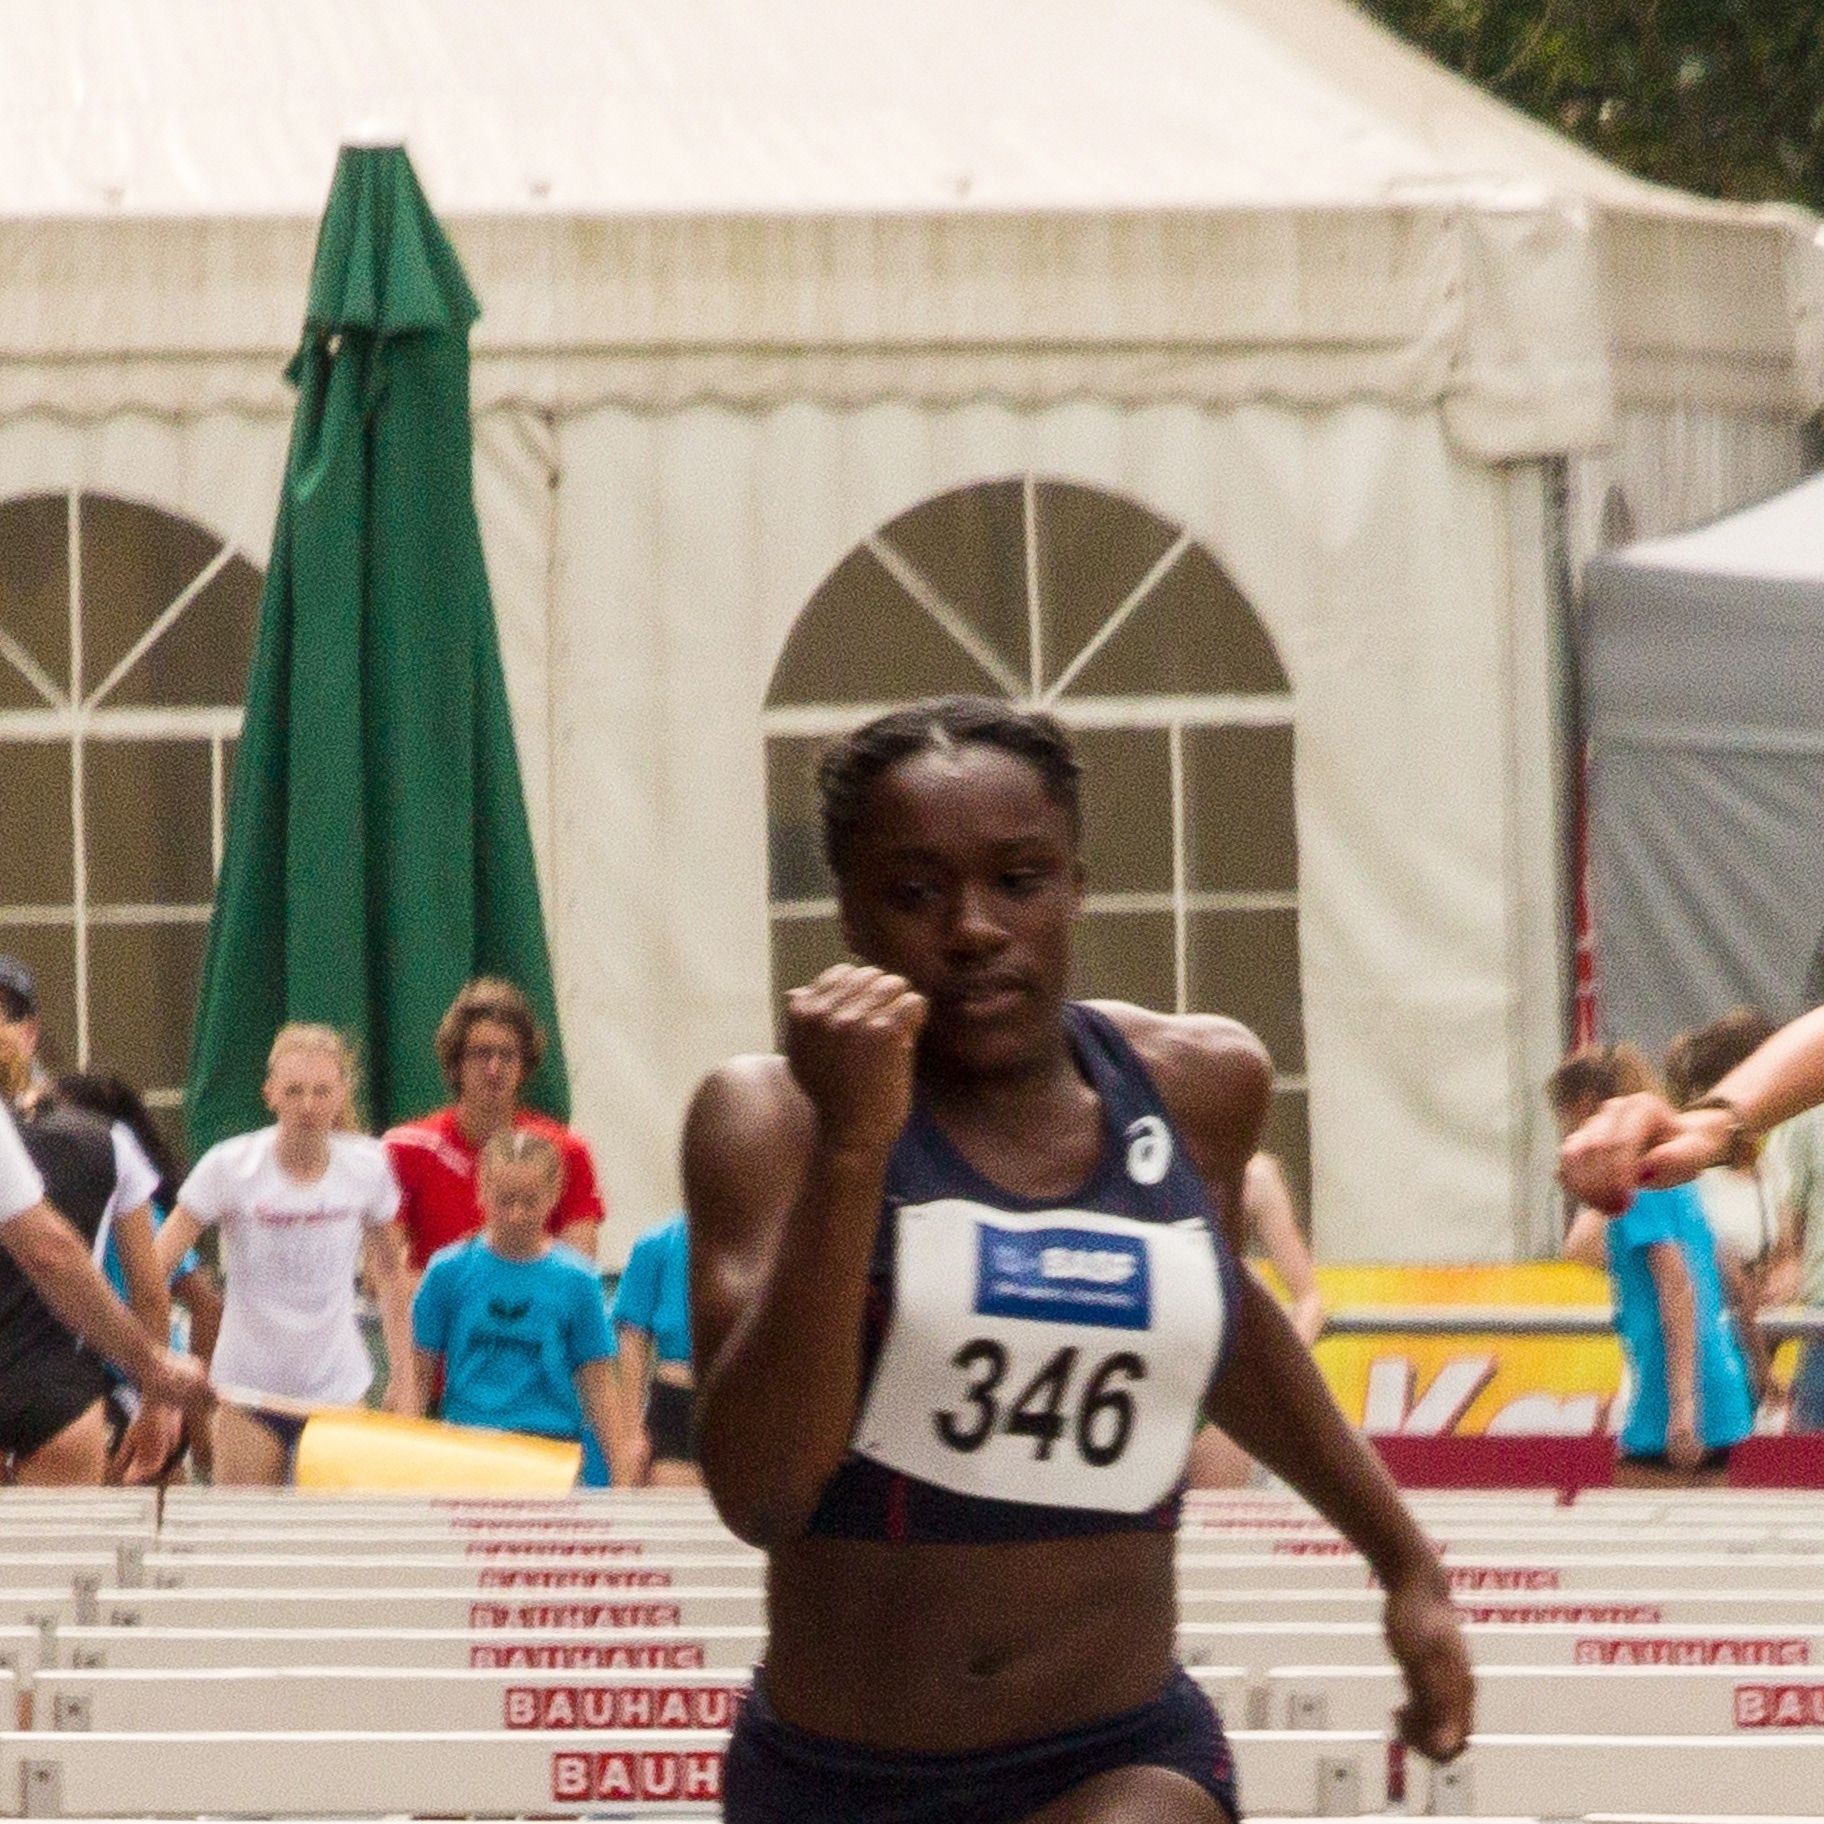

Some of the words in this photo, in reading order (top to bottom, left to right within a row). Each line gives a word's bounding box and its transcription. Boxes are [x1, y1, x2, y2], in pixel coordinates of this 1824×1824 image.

[935, 1338, 1149, 1468] 346
[507, 1690, 728, 1725] BAUHAU
[556, 1756, 722, 1796] BAUH
